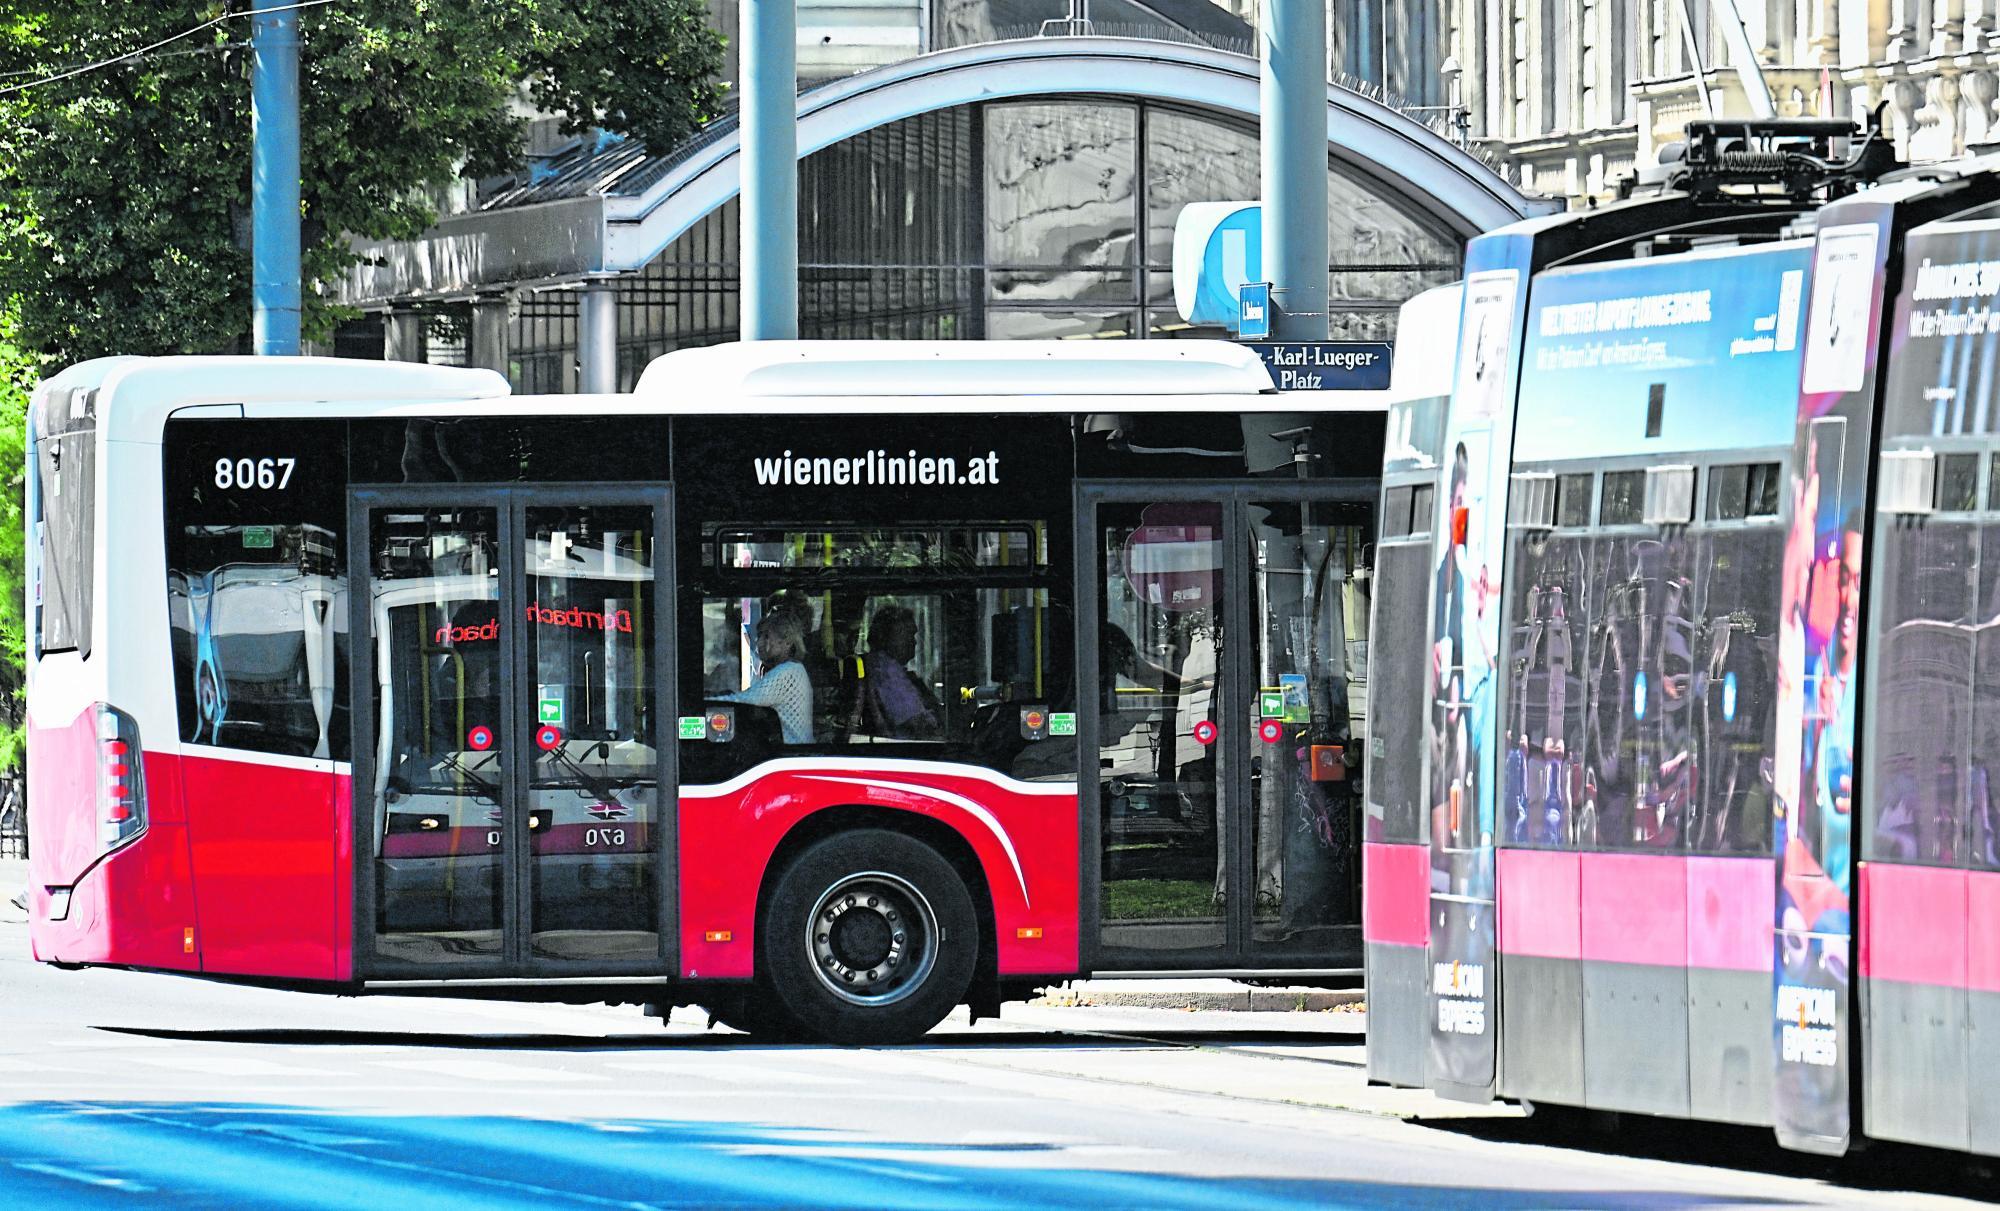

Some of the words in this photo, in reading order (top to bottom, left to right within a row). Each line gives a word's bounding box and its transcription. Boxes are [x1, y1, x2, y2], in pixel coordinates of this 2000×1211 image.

[1257, 347, 1379, 370] .-Karl-Lueger-
[1281, 371, 1322, 390] Platz
[215, 458, 295, 490] 8067
[754, 450, 1000, 485] wienerlinien.at
